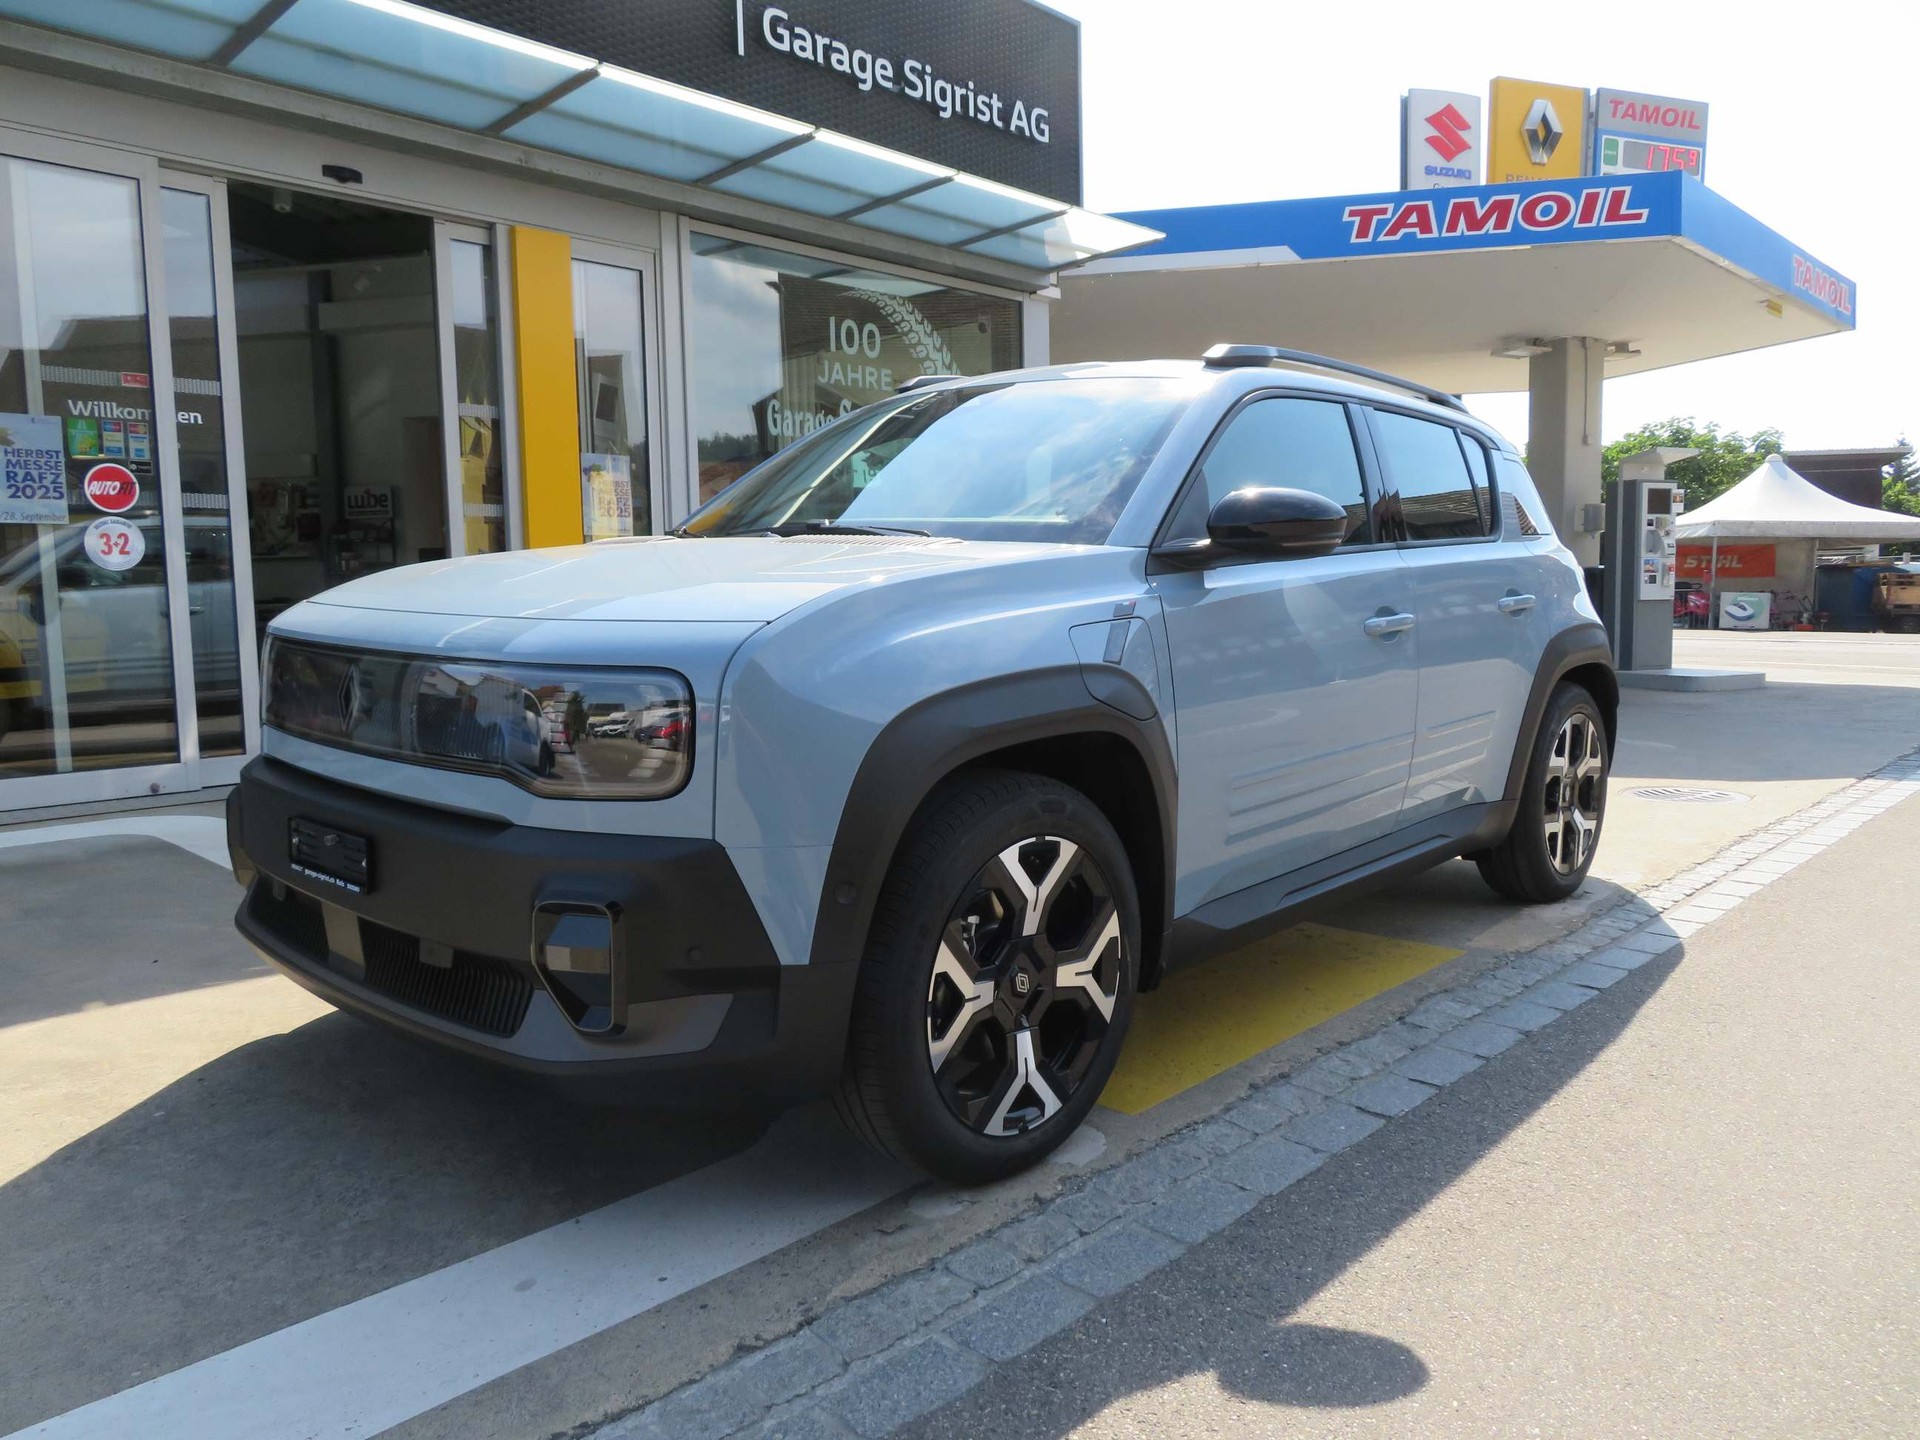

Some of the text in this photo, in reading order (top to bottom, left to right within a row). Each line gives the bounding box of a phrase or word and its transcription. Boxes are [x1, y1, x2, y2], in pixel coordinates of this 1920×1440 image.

[763, 8, 1050, 143] Garage Sigrist AG
[1608, 99, 1700, 130] TAMOIL
[1424, 165, 1471, 180] SUZUKI
[1343, 186, 1648, 243] TAMOIL
[1793, 254, 1851, 315] TAMOIL
[829, 316, 881, 359] 100
[817, 360, 893, 391] JAHRE
[4, 447, 61, 459] HERBST
[5, 459, 63, 471] MESSE
[6, 470, 63, 484] RAFZ
[7, 483, 65, 499] 2025
[20, 511, 66, 522] September
[98, 532, 131, 555] 3+2
[1684, 555, 1743, 569] STHL
